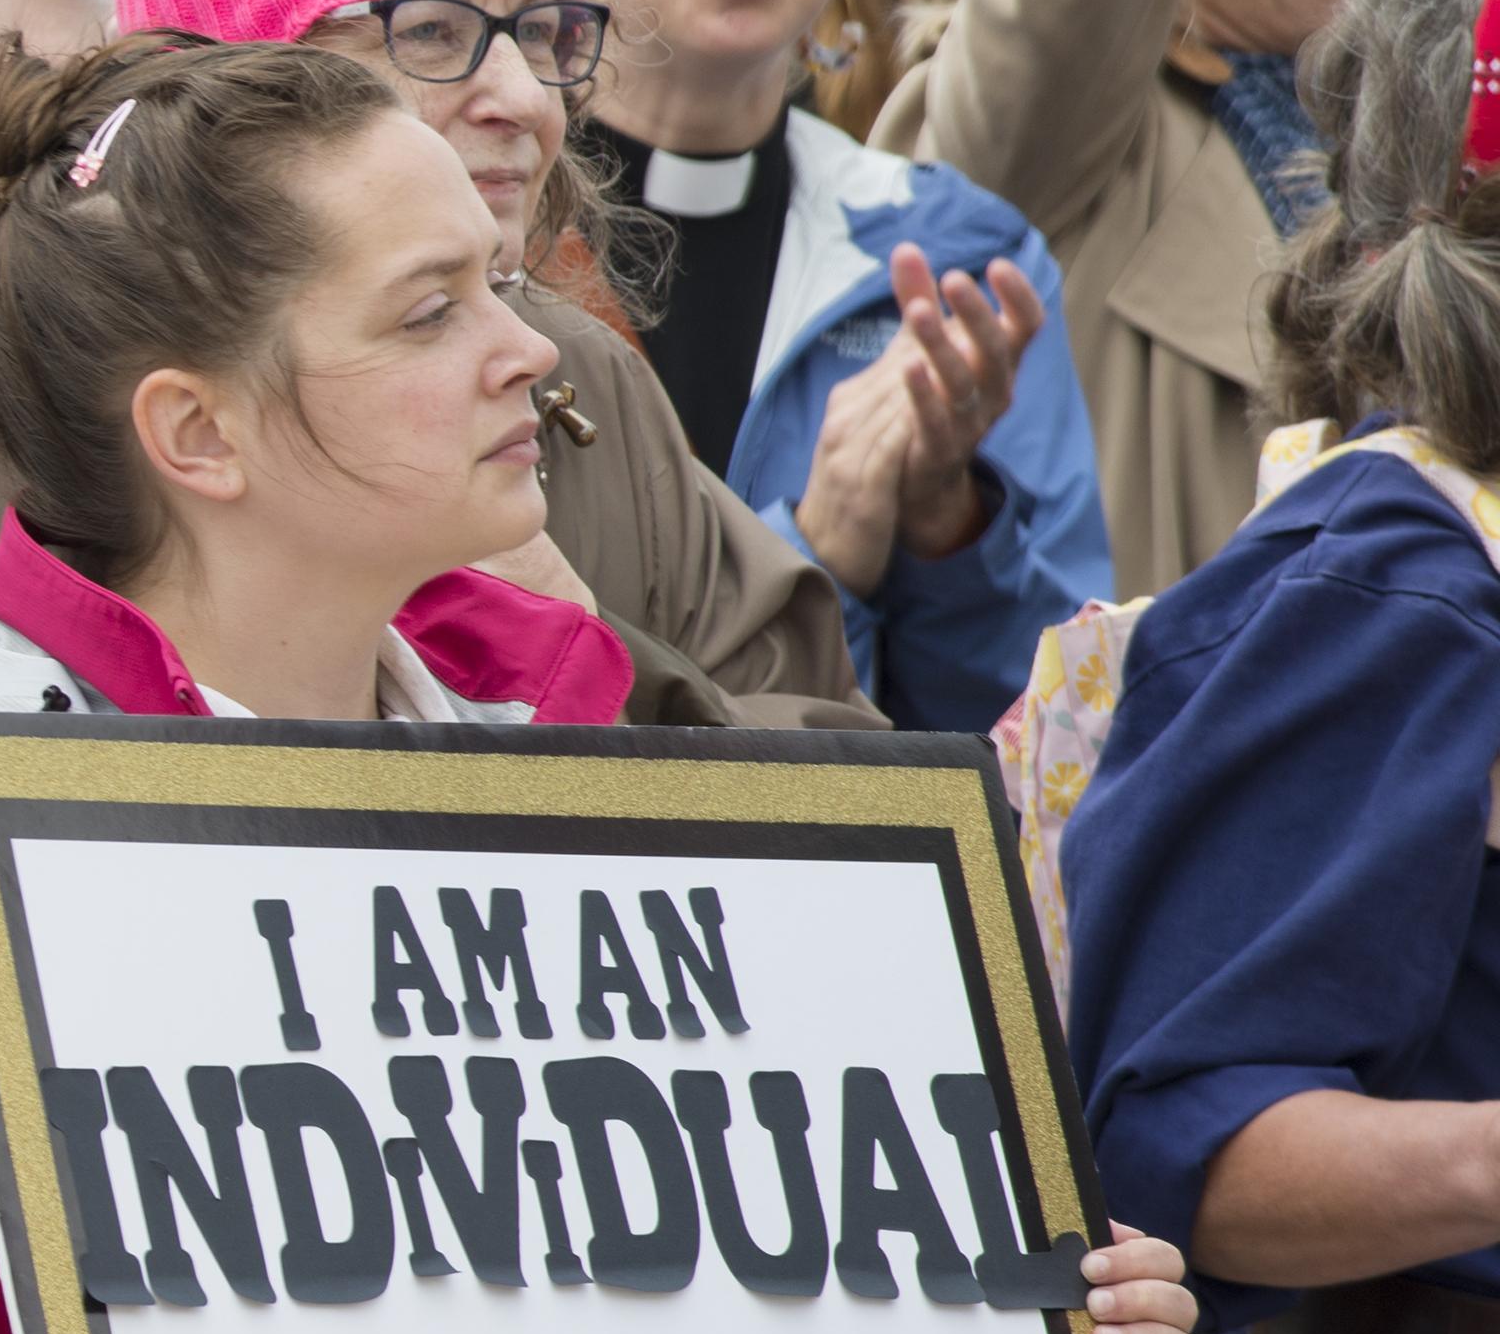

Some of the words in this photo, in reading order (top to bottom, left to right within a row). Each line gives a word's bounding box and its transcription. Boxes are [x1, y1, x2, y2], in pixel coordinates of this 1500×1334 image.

[253, 897, 322, 1052] I
[369, 884, 554, 1041] AM
[574, 885, 752, 1042] AN
